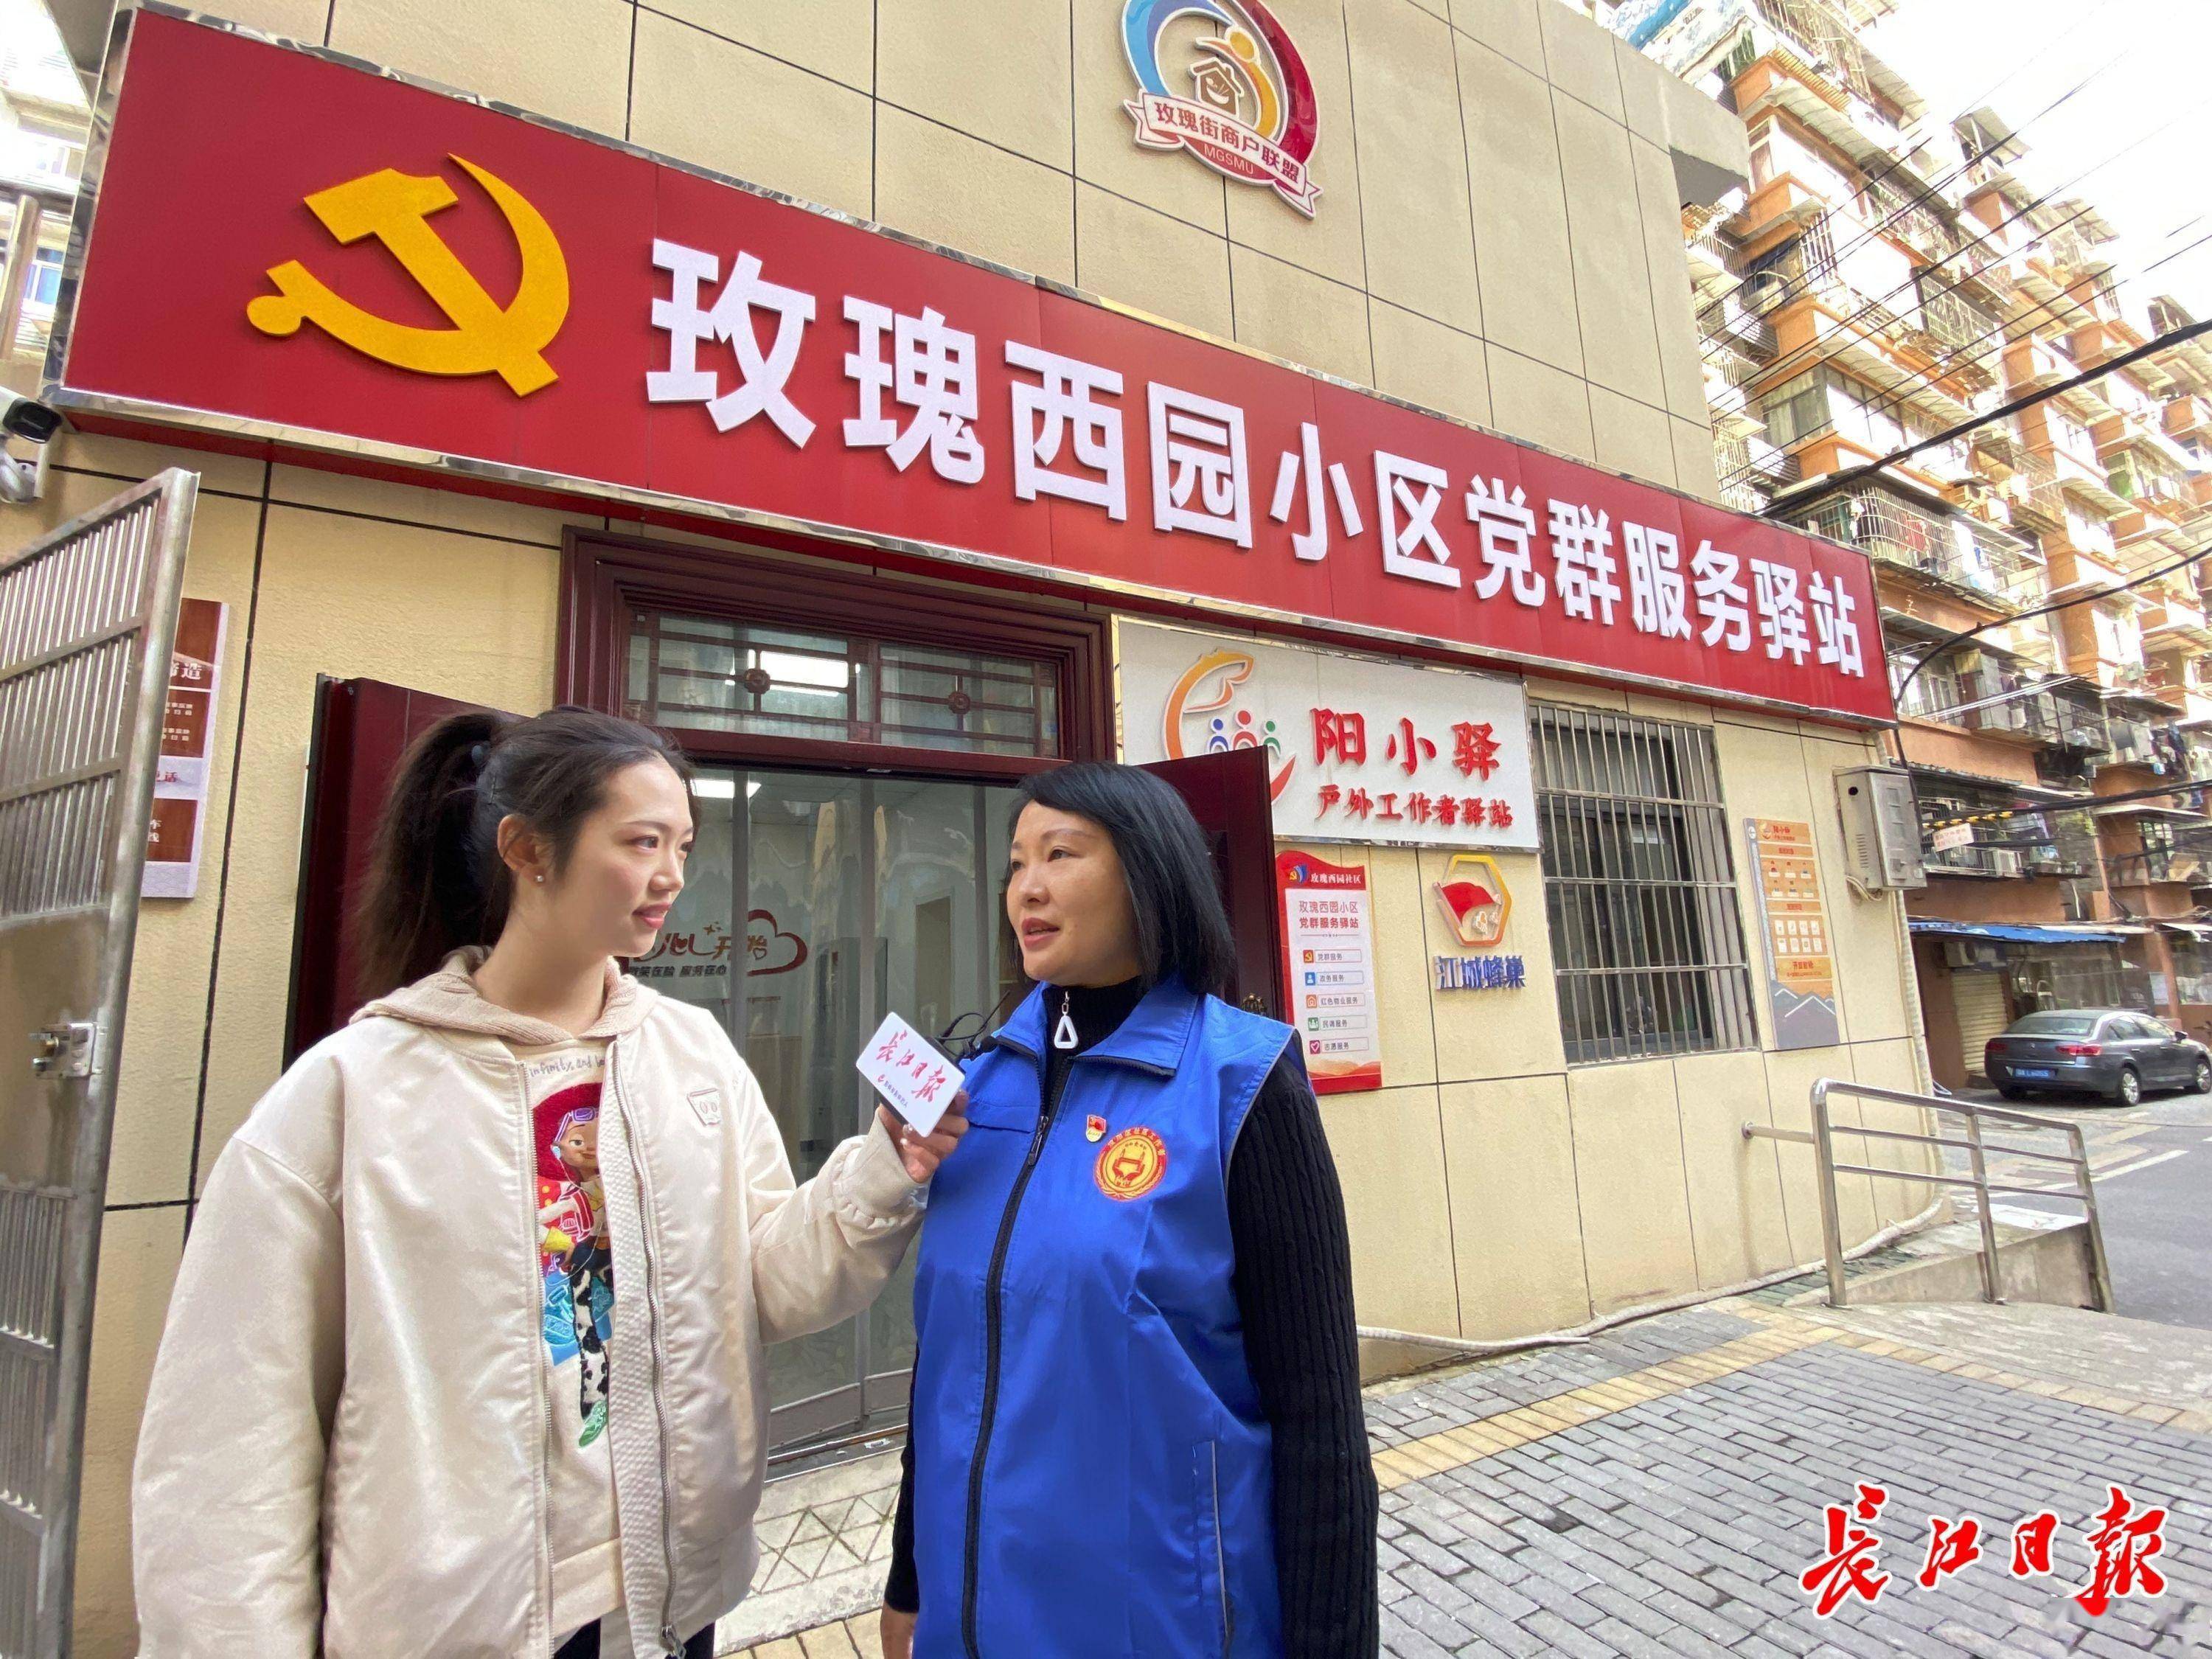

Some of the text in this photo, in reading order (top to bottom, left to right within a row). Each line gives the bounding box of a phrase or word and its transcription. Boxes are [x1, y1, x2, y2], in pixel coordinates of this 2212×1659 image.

[1155, 101, 1299, 184] 玫瑰街商户联盟
[1204, 144, 1253, 174] MGSMU
[646, 238, 1864, 678] 玫瑰西园小区党群服务驿站
[1310, 708, 1501, 782] 阳小驿
[1314, 784, 1513, 828] 户外工作者驿站
[1310, 872, 1362, 884] 玫瑰西园社区
[1298, 900, 1359, 914] 玫瑰西园小区
[1298, 917, 1359, 929] 党群服务驿站
[1317, 953, 1343, 961] 党群服务
[680, 964, 728, 978] 服务在心
[1319, 974, 1345, 983] 政务服务
[1434, 954, 1526, 990] 江城蜂巢
[1321, 997, 1358, 1006] 红色物业服务
[876, 1029, 947, 1103] 长江日报
